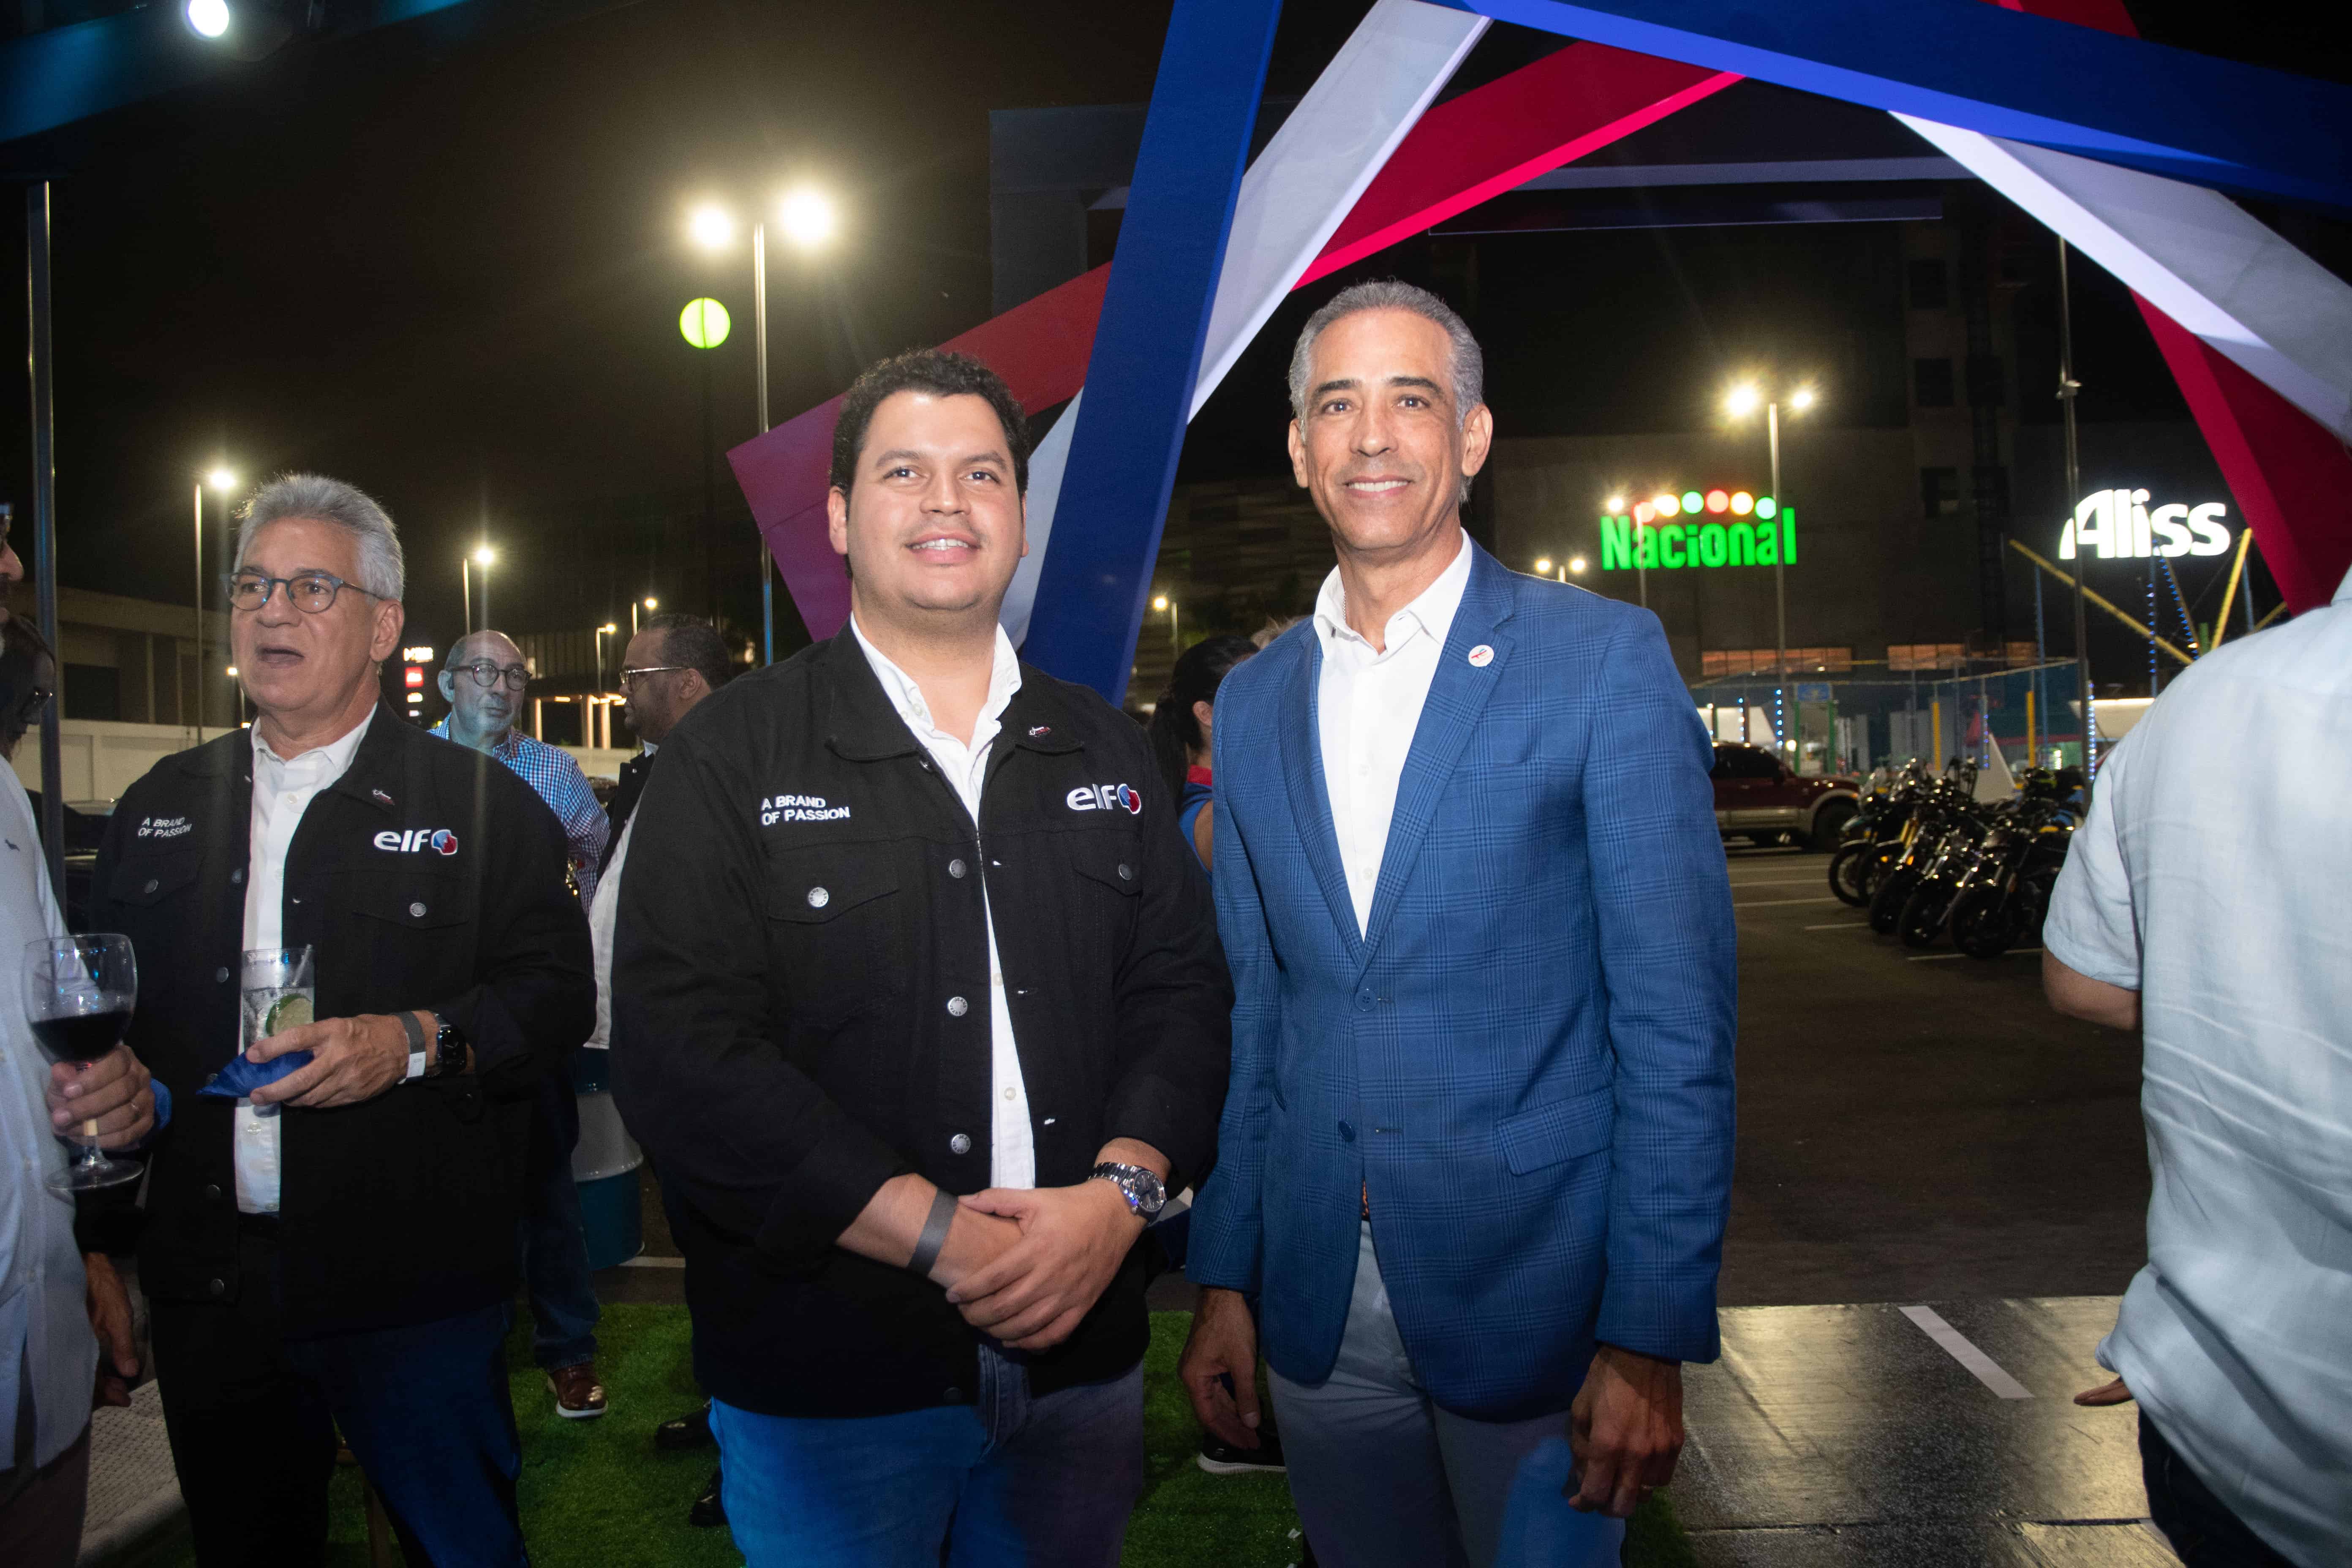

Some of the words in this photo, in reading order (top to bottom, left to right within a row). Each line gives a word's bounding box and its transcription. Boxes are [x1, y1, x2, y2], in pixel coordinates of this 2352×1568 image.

[2058, 489, 2231, 559] Aliss
[1600, 506, 1797, 570] Nacional
[761, 798, 772, 811] A
[776, 795, 826, 808] BRAND
[1067, 784, 1117, 811] elf
[142, 817, 150, 826] A
[153, 817, 185, 827] BRAND
[762, 811, 781, 825] OF
[784, 806, 851, 821] PASSION
[138, 828, 153, 836] OF
[154, 824, 192, 837] PASSION
[374, 829, 431, 852] elf
